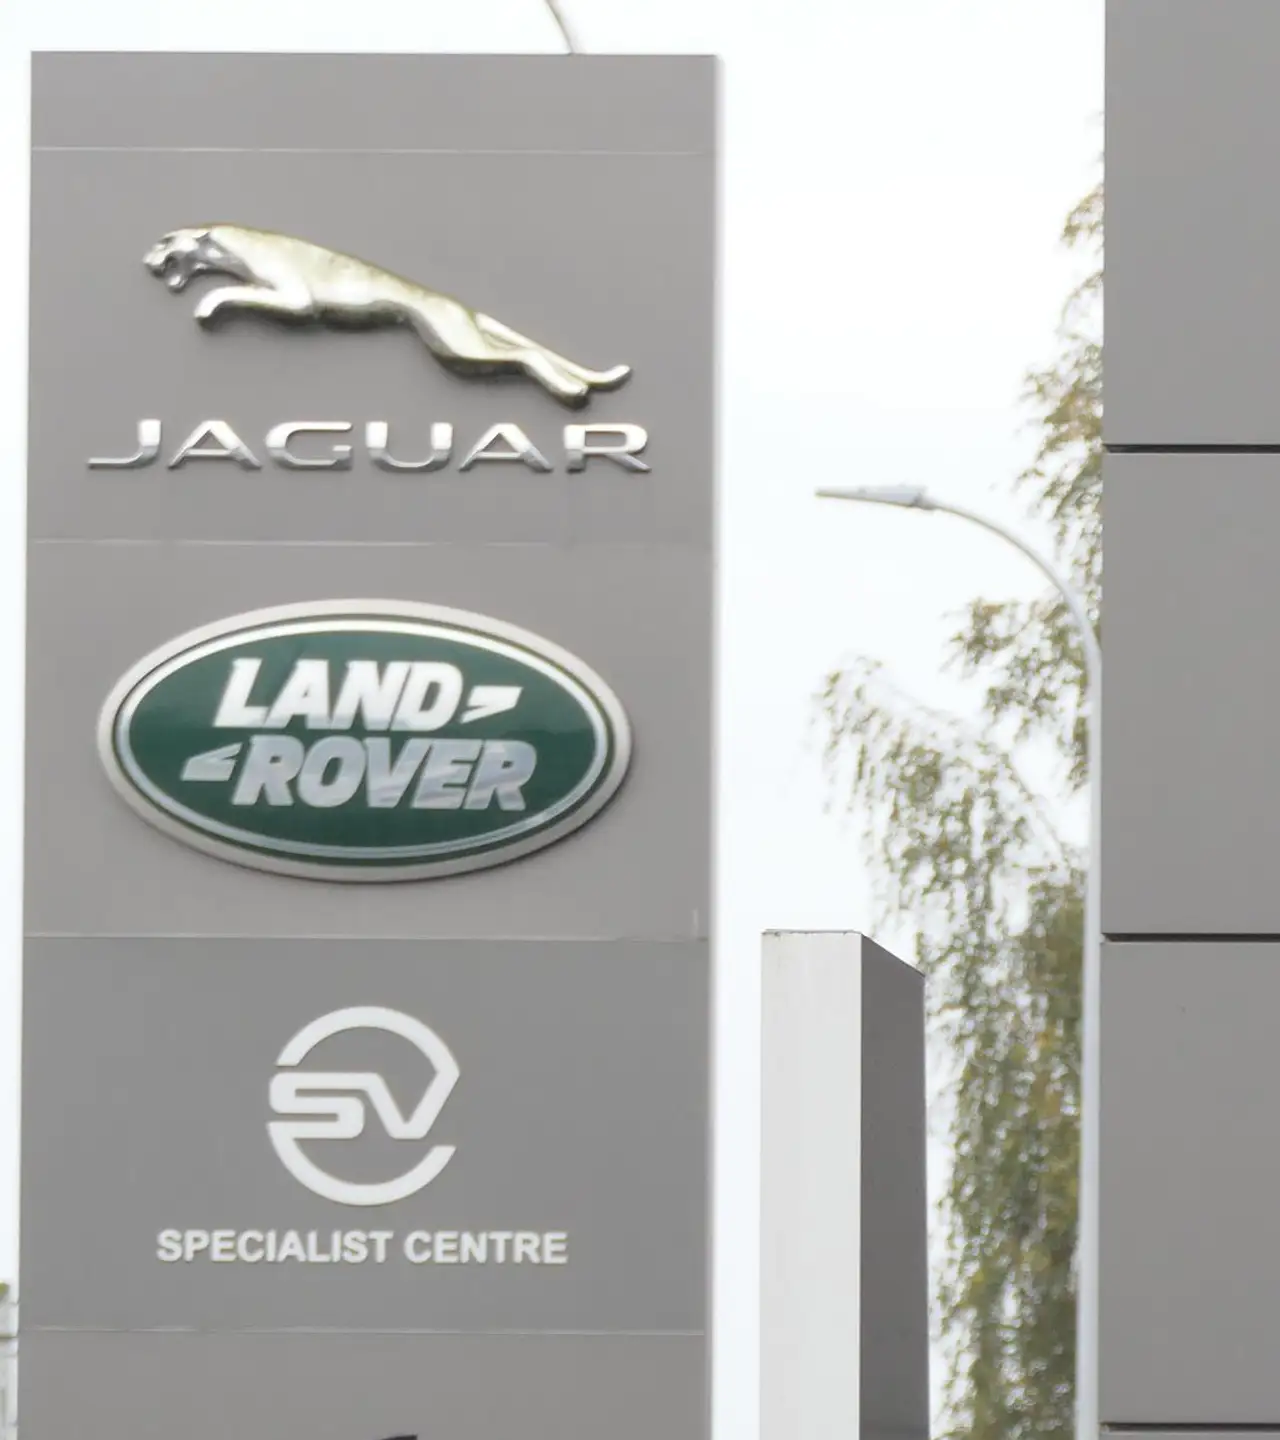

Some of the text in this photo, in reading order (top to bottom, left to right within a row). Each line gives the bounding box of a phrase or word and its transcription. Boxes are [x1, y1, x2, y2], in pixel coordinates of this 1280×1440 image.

[87, 418, 652, 474] JAGUAR
[213, 657, 464, 731] LAND
[231, 734, 537, 811] ROVER
[156, 1228, 569, 1265] SPECIALIST CENTRE
